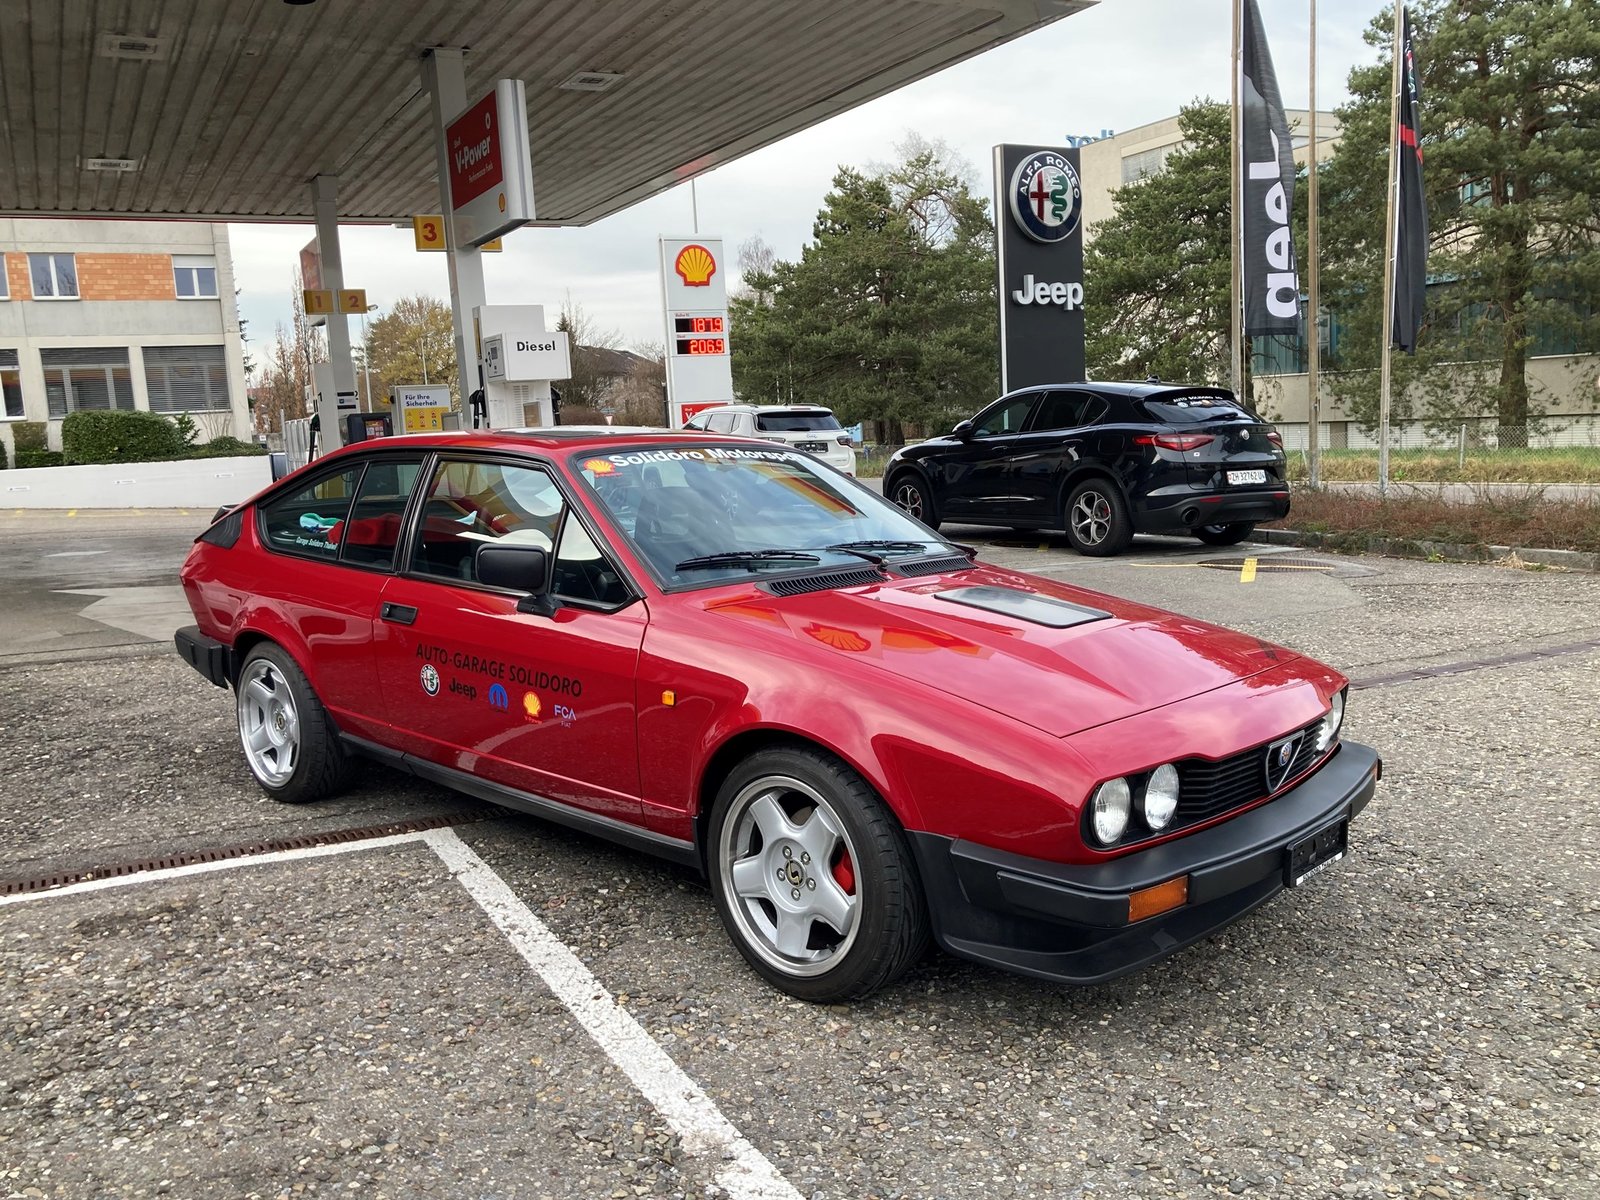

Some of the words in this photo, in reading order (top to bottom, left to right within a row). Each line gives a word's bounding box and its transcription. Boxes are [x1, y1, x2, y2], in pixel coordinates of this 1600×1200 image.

[455, 135, 491, 174] V-Power
[1020, 160, 1042, 196] ALFA
[1046, 156, 1080, 199] ROMEO
[423, 222, 438, 242] 3
[315, 296, 322, 308] 1
[350, 295, 359, 308] 2
[1013, 274, 1084, 311] Jeep
[517, 340, 556, 351] Diesel
[690, 339, 724, 354] 206.9
[611, 448, 704, 468] Solidoro
[703, 448, 802, 462] Motorspor
[1231, 472, 1240, 482] ZH
[416, 643, 504, 679] AUTO-GARAGE
[509, 664, 582, 697] SOLIDORO
[448, 678, 477, 700] Jeep
[554, 704, 577, 721] FCA
